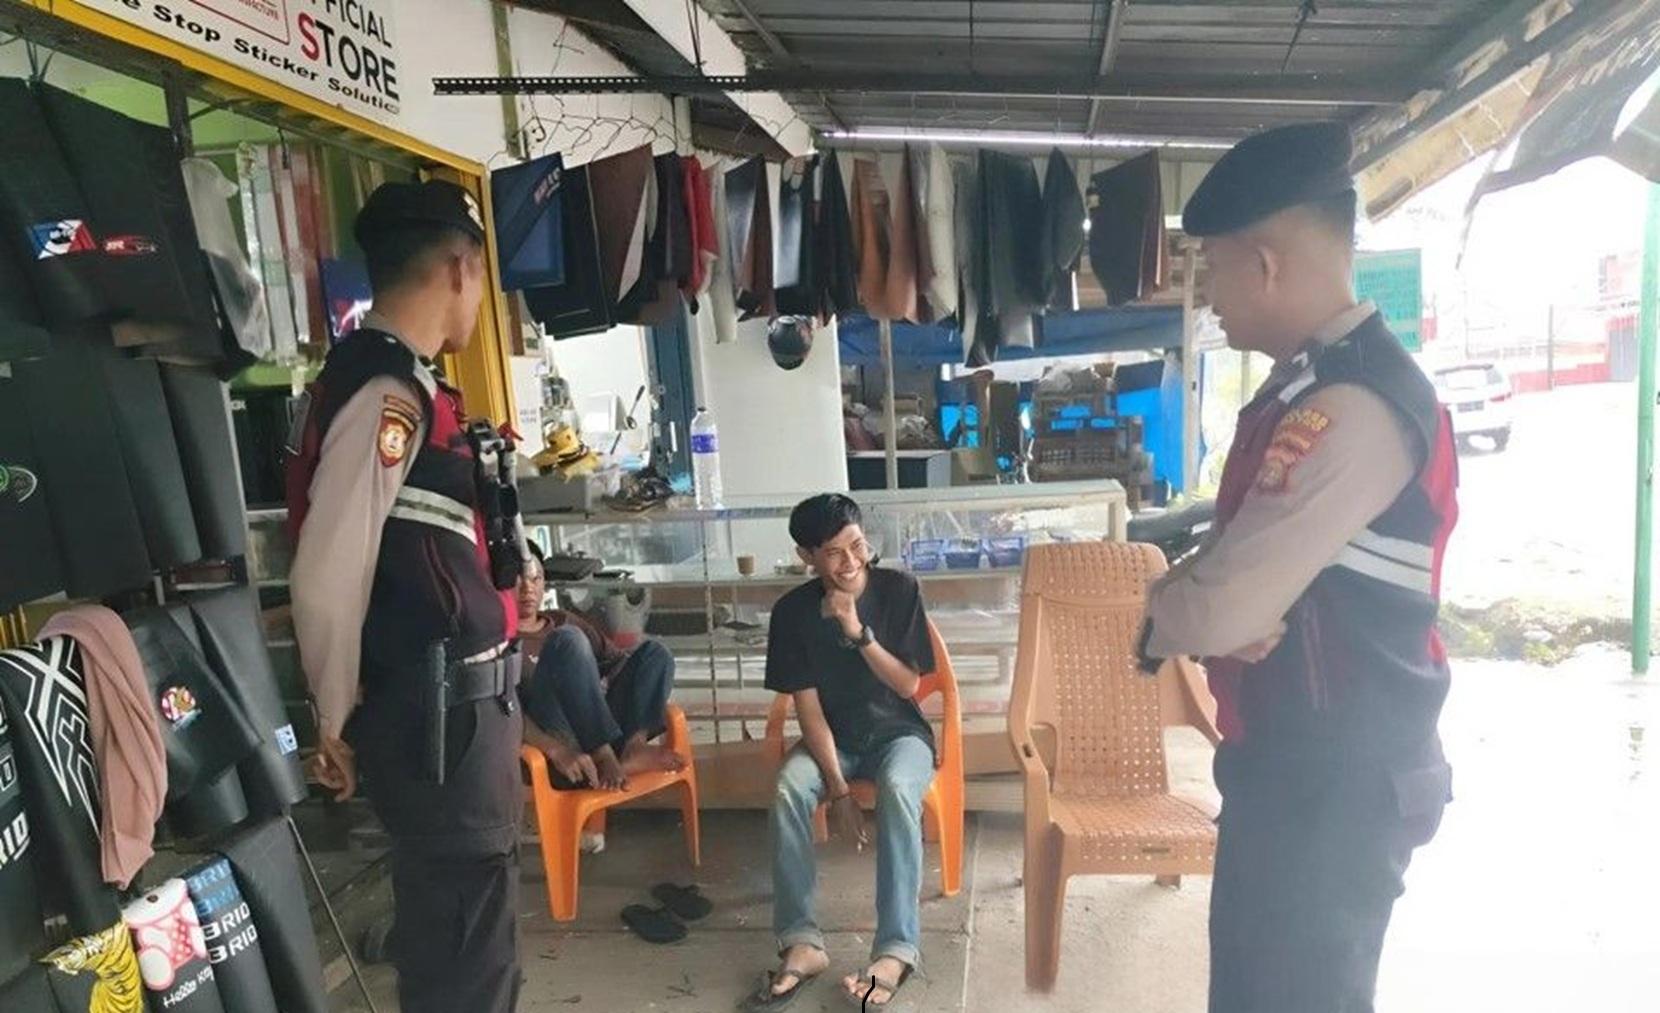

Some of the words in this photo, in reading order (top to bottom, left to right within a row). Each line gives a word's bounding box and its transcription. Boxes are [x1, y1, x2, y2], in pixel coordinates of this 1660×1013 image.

[153, 4, 221, 43] Stop
[233, 37, 320, 83] Sticker
[297, 12, 400, 102] STORE
